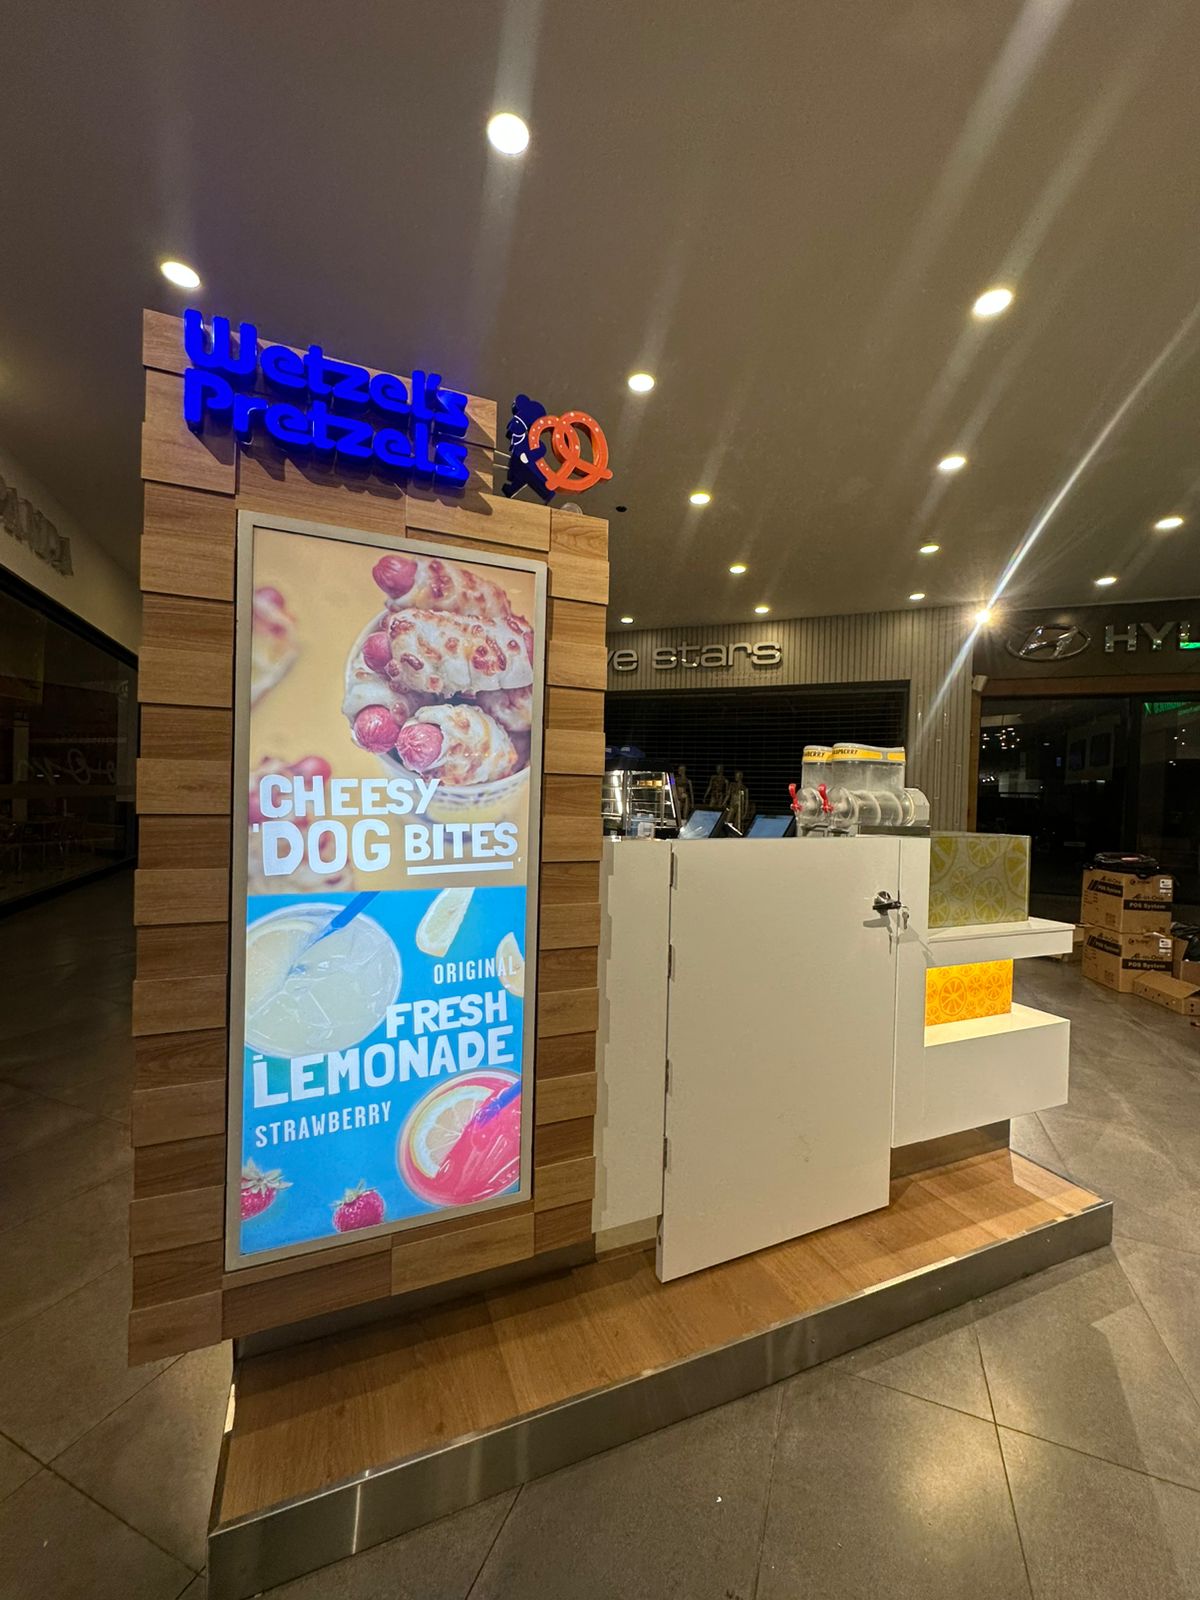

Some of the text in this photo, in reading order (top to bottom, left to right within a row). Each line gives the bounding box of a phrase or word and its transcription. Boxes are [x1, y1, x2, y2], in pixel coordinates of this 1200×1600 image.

[184, 308, 469, 437] Wetzel's
[184, 367, 469, 488] Pretzels
[653, 641, 782, 669] stars
[259, 774, 440, 818] CHEESY
[262, 819, 518, 876] DOG BITES
[433, 956, 517, 984] ORIGINAL
[386, 990, 508, 1038] FRESH
[253, 1025, 514, 1108] LEMONADE
[255, 1101, 392, 1148] STRAWBERRY
